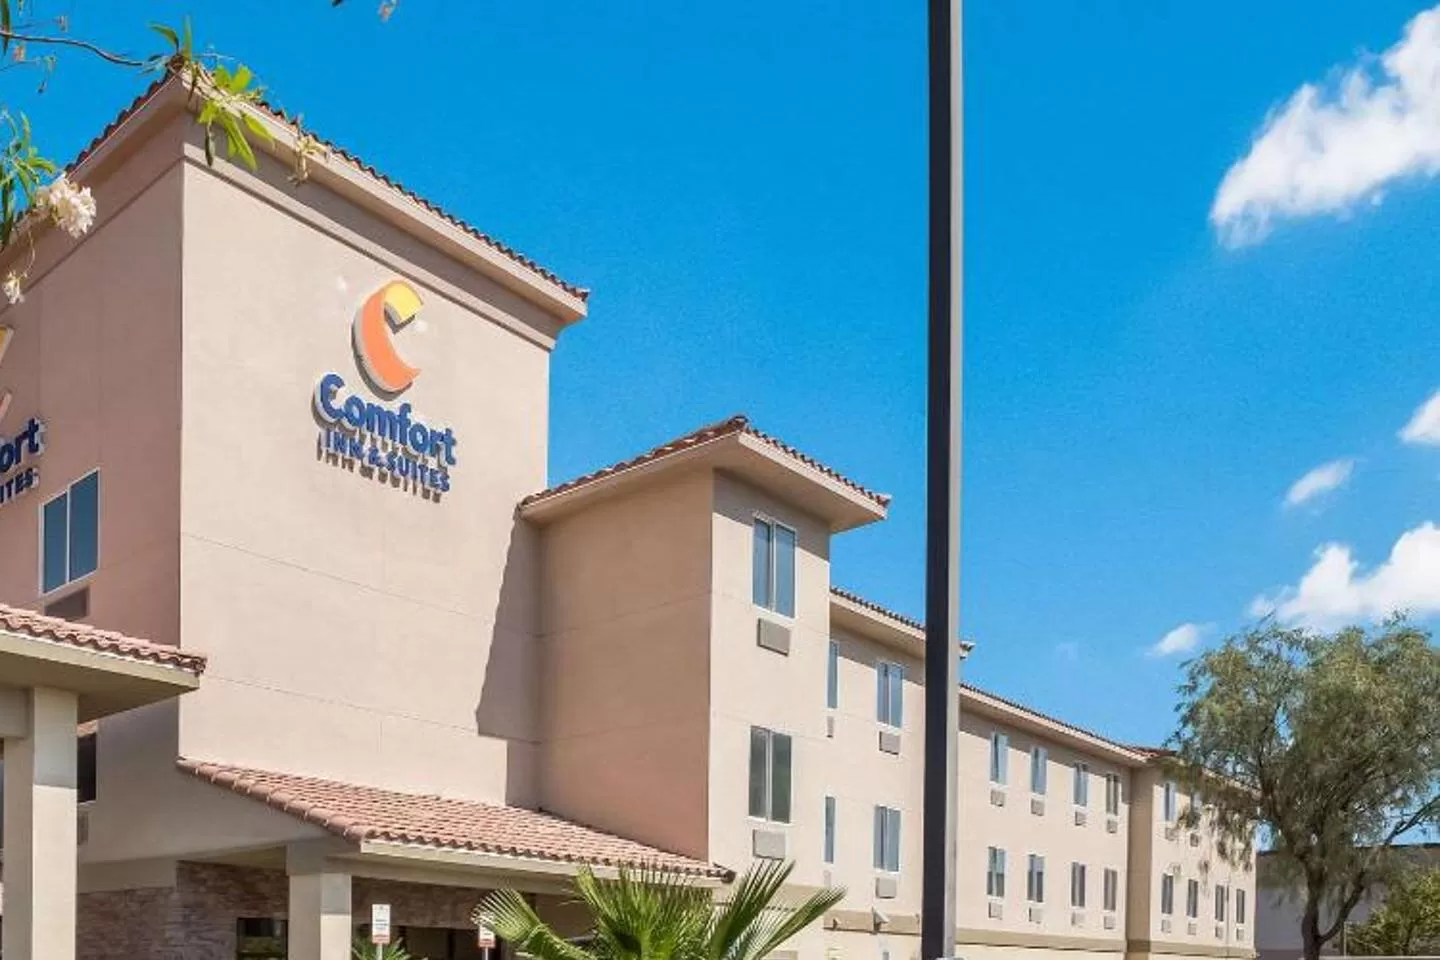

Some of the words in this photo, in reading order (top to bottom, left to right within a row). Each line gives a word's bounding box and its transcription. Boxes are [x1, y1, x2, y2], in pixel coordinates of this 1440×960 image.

[320, 373, 457, 466] Comfort
[325, 426, 364, 460] INN
[368, 446, 385, 468] &
[386, 451, 450, 492] SUITES
